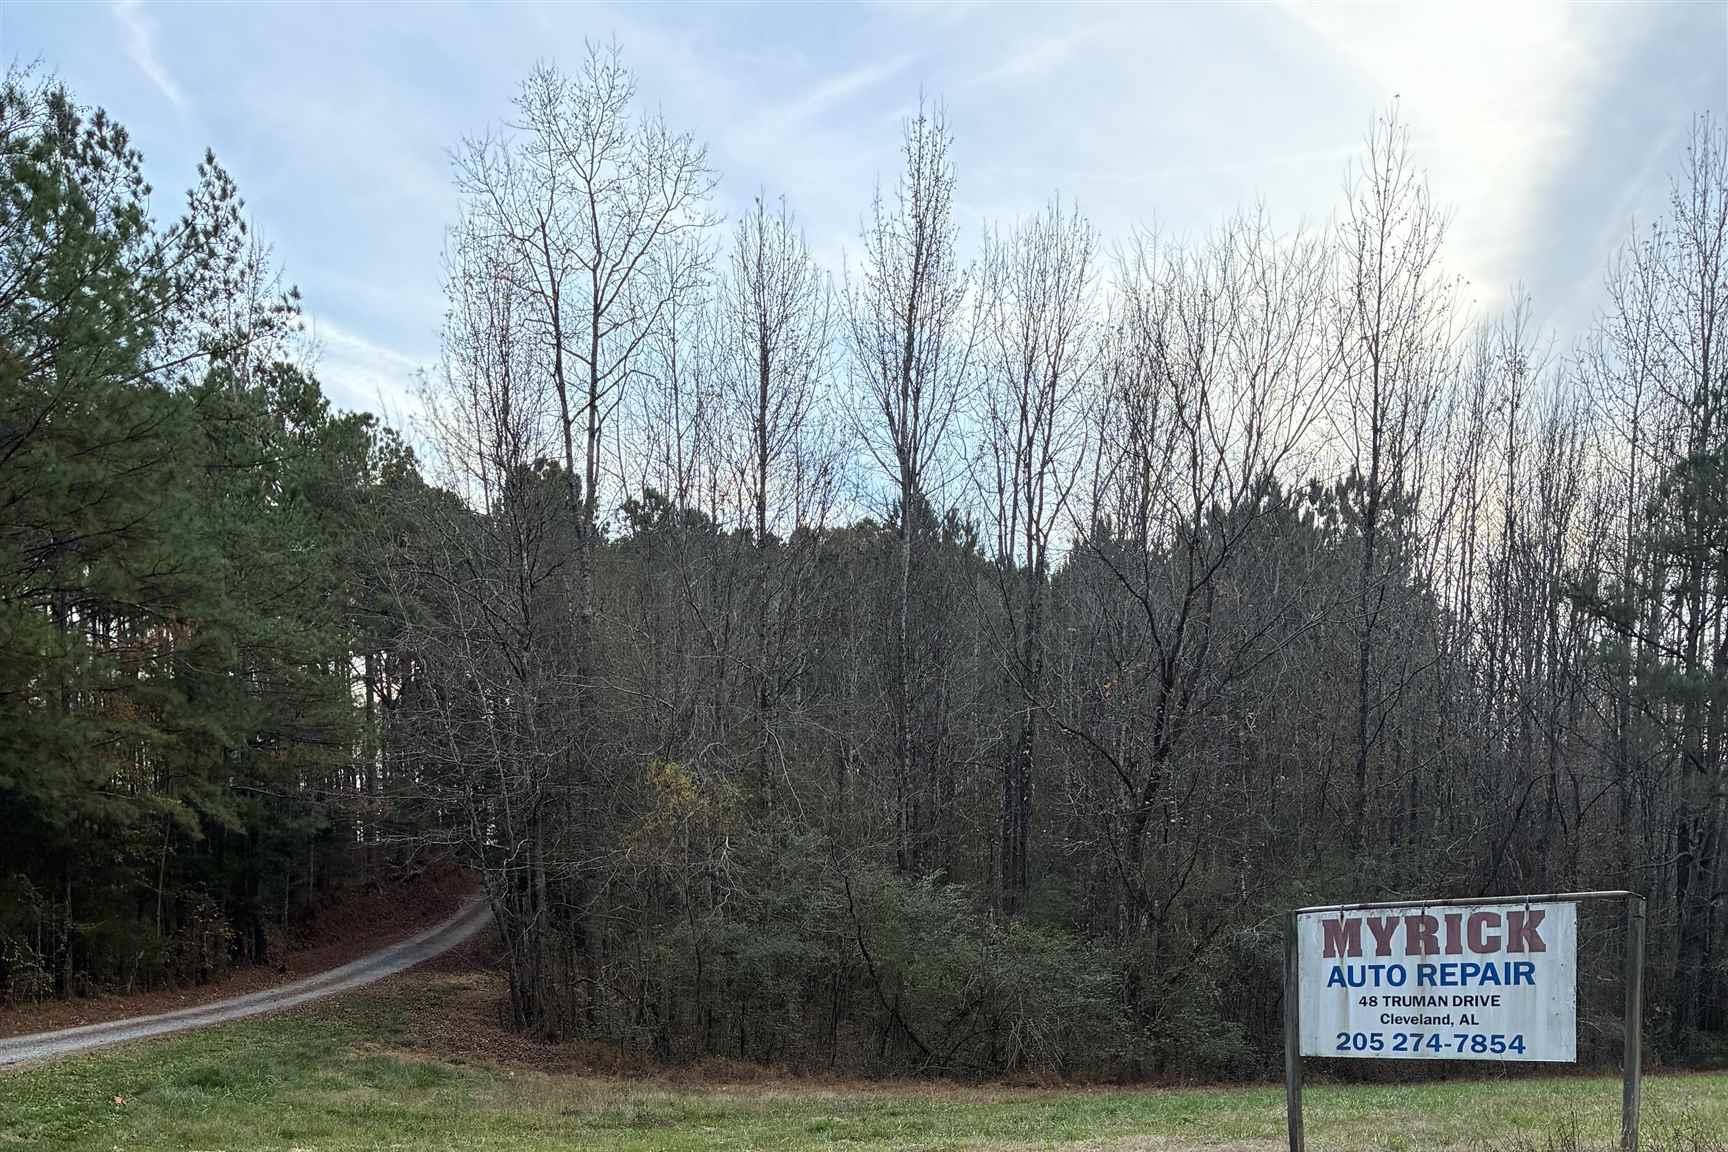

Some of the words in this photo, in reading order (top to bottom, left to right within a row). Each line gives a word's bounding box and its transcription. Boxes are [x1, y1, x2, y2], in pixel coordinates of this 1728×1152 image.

[1322, 910, 1547, 959] MYRICK
[1327, 964, 1407, 988] AUTO
[1416, 961, 1536, 987] REPAIR
[1358, 995, 1378, 1007] 48
[1382, 995, 1449, 1007] TRUMAN
[1452, 995, 1501, 1007] DRIVE
[1380, 1013, 1454, 1027] Cleveland,
[1459, 1014, 1479, 1026] AL
[1336, 1032, 1385, 1051] 205
[1392, 1032, 1526, 1054] 274-7854
